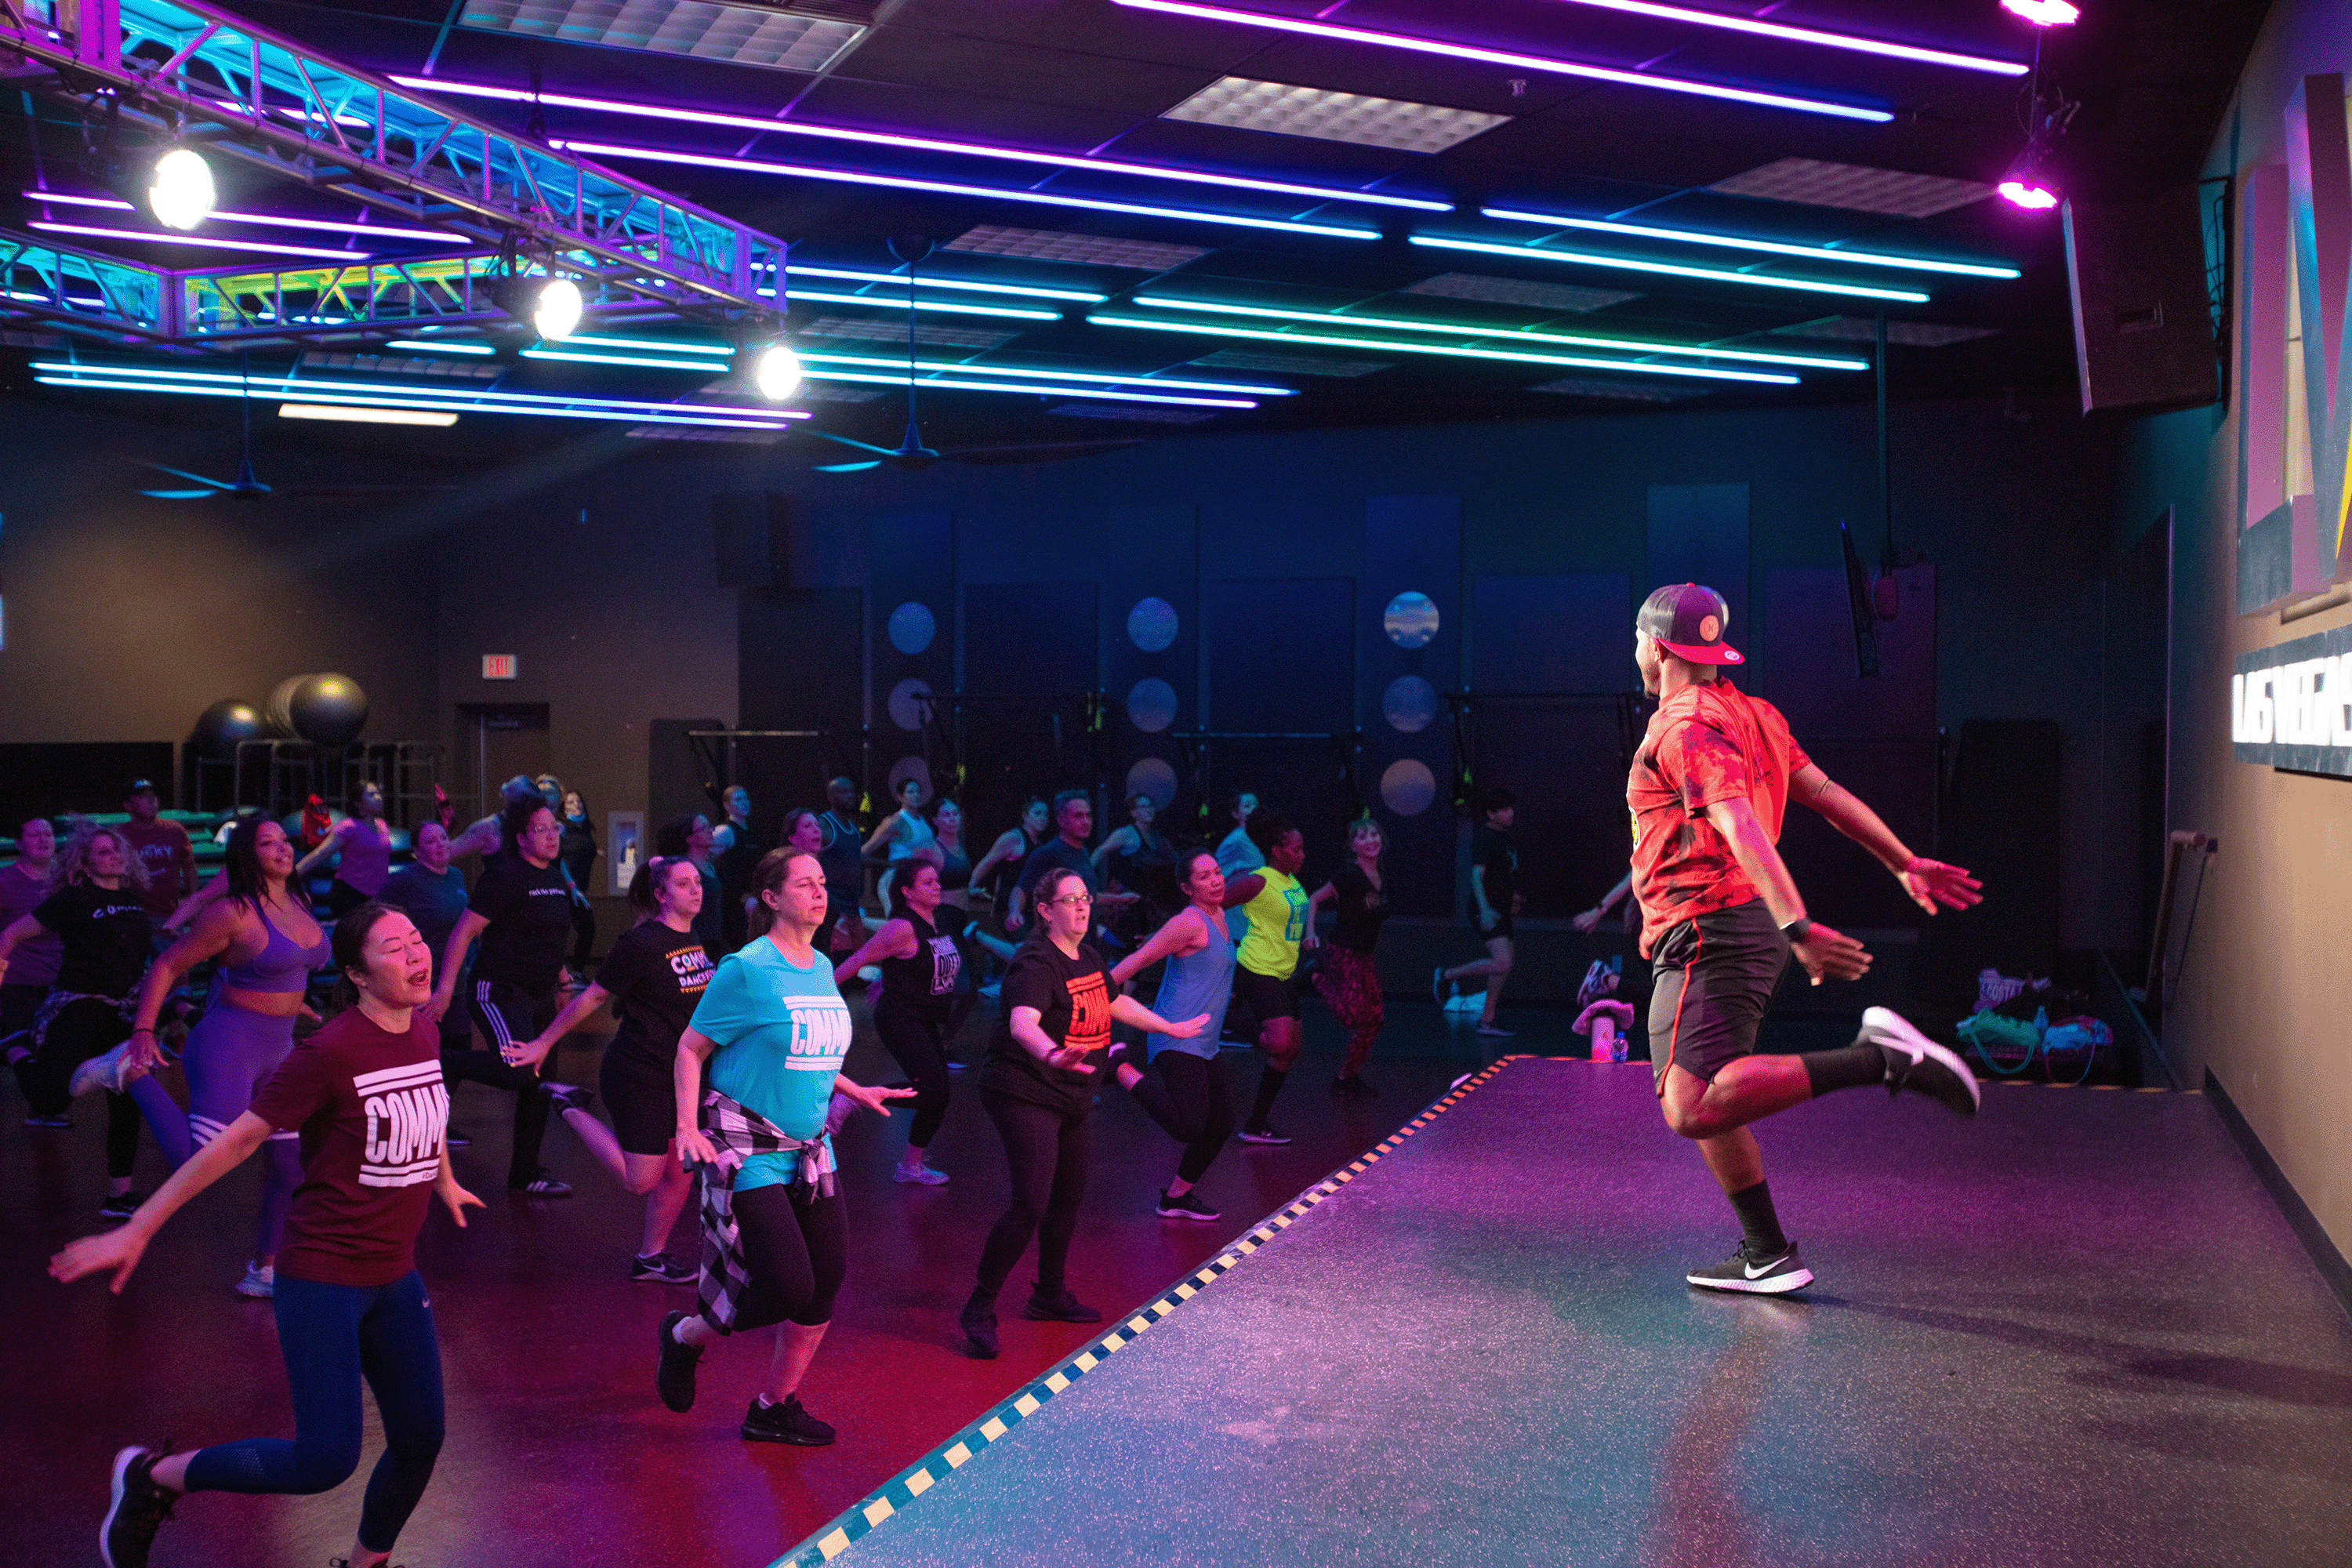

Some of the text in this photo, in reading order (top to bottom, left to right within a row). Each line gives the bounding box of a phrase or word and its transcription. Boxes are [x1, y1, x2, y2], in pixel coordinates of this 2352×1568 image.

[488, 656, 509, 677] EXIT
[789, 1009, 853, 1055] COMM
[365, 1083, 450, 1164] COMM
